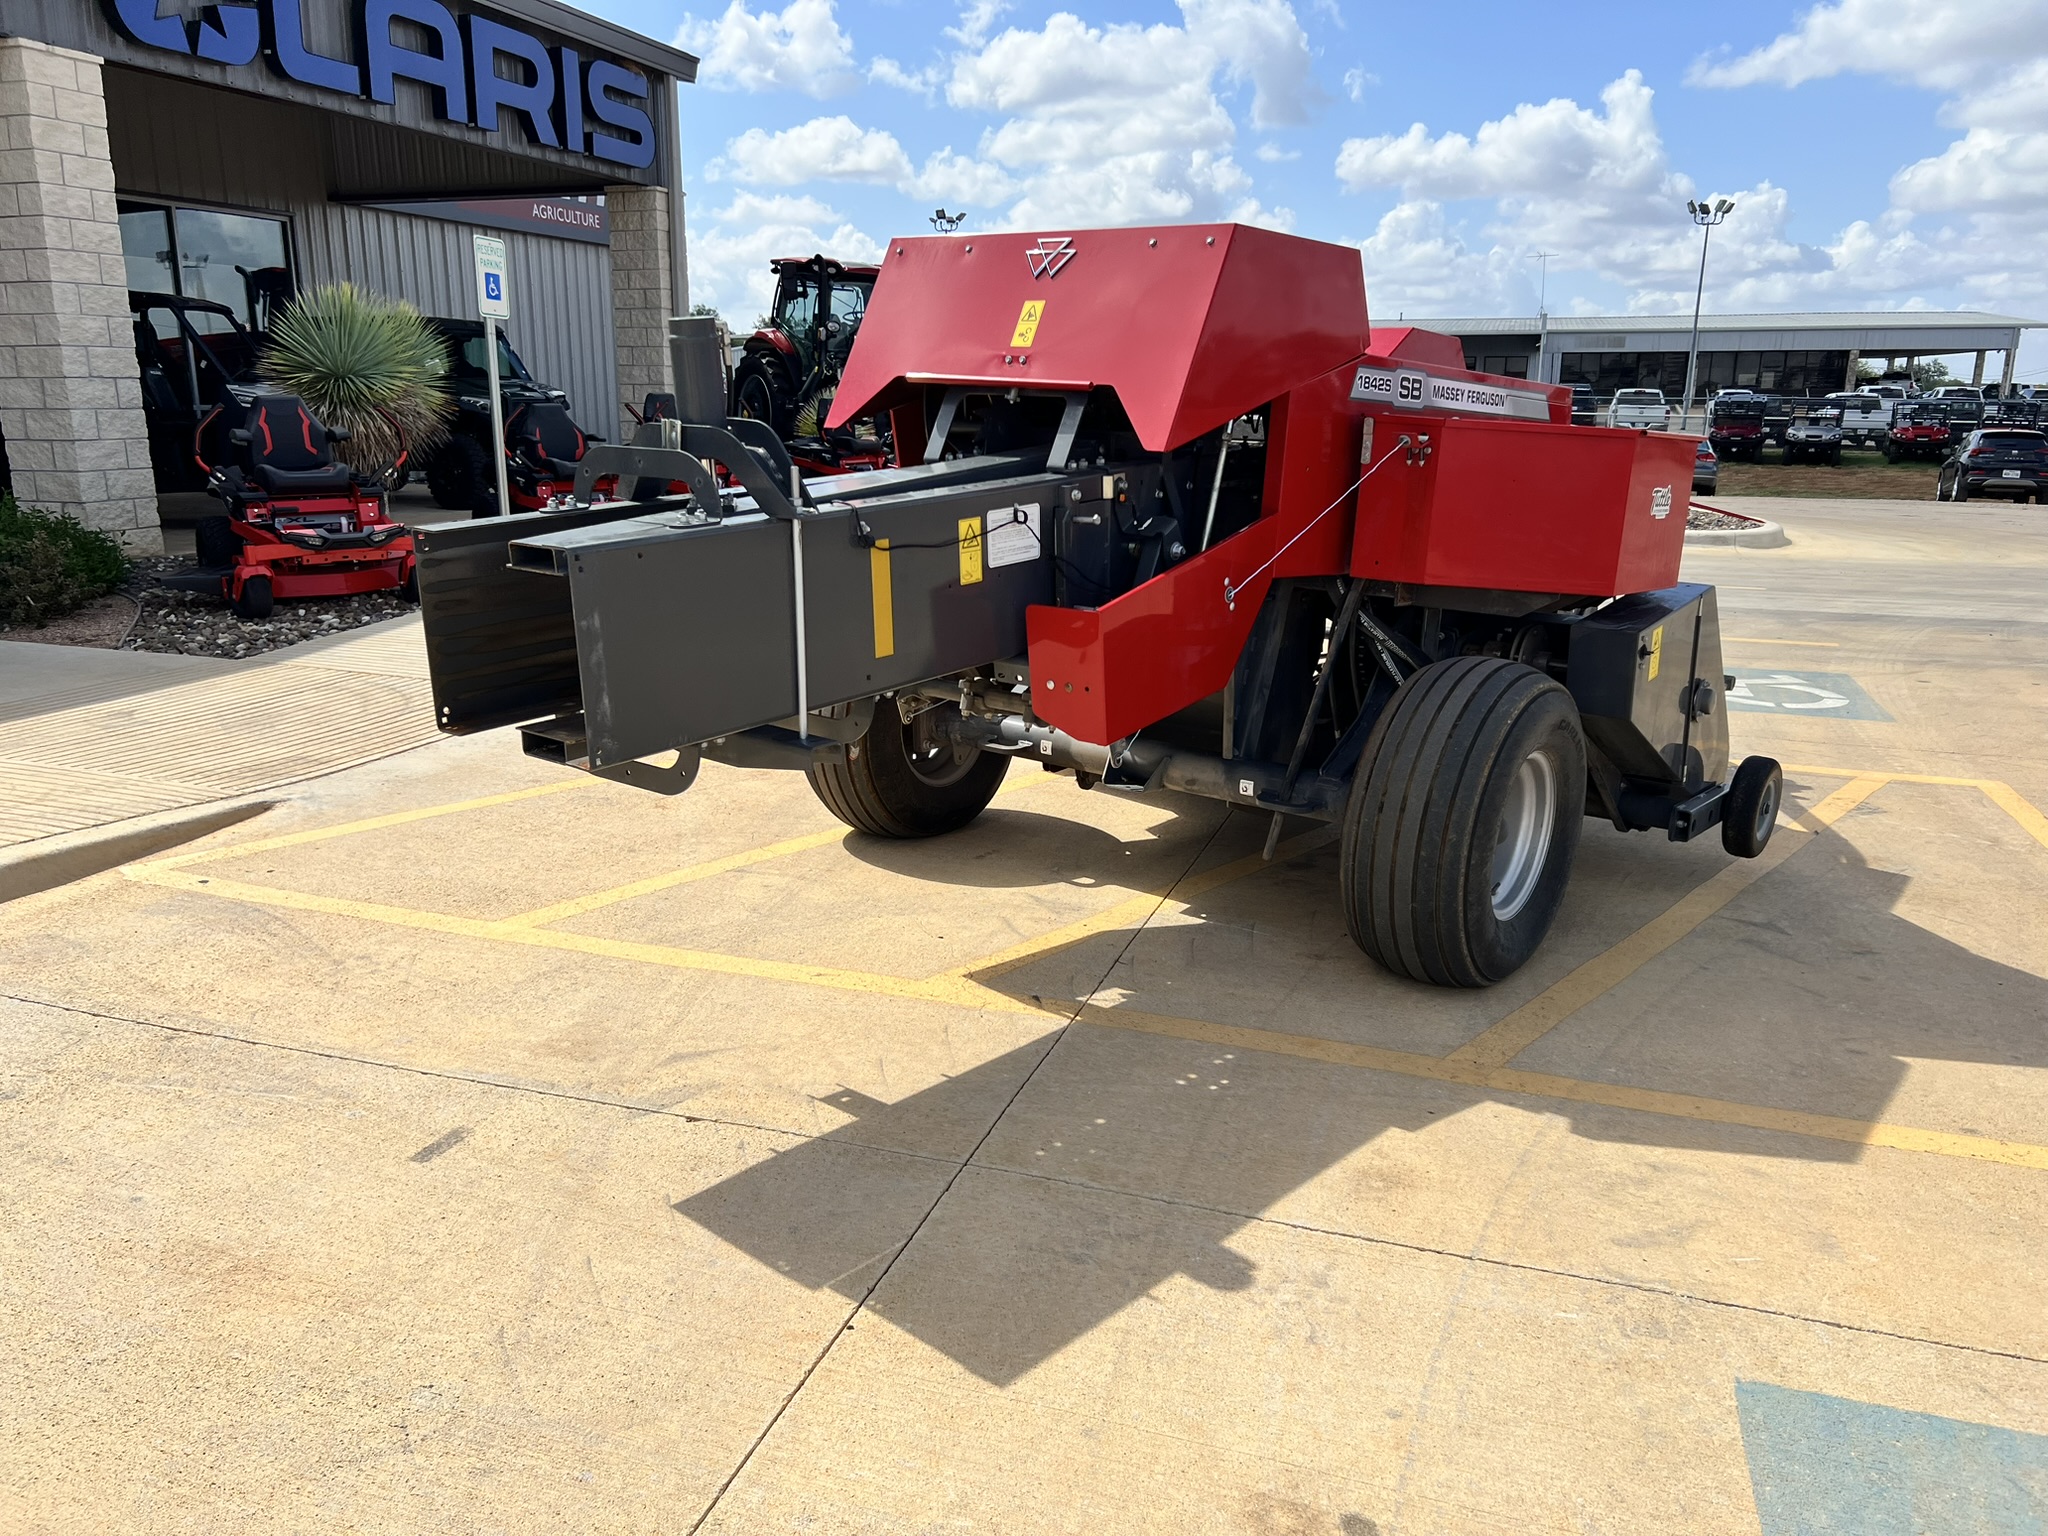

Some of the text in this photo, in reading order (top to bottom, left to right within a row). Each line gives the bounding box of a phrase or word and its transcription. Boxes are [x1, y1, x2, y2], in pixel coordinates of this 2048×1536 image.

[532, 203, 601, 228] AGRICULTURE
[477, 243, 503, 258] RESERVED
[480, 257, 503, 271] PARKING
[1357, 374, 1506, 407] 1842S SB MASSEY FERGUSON
